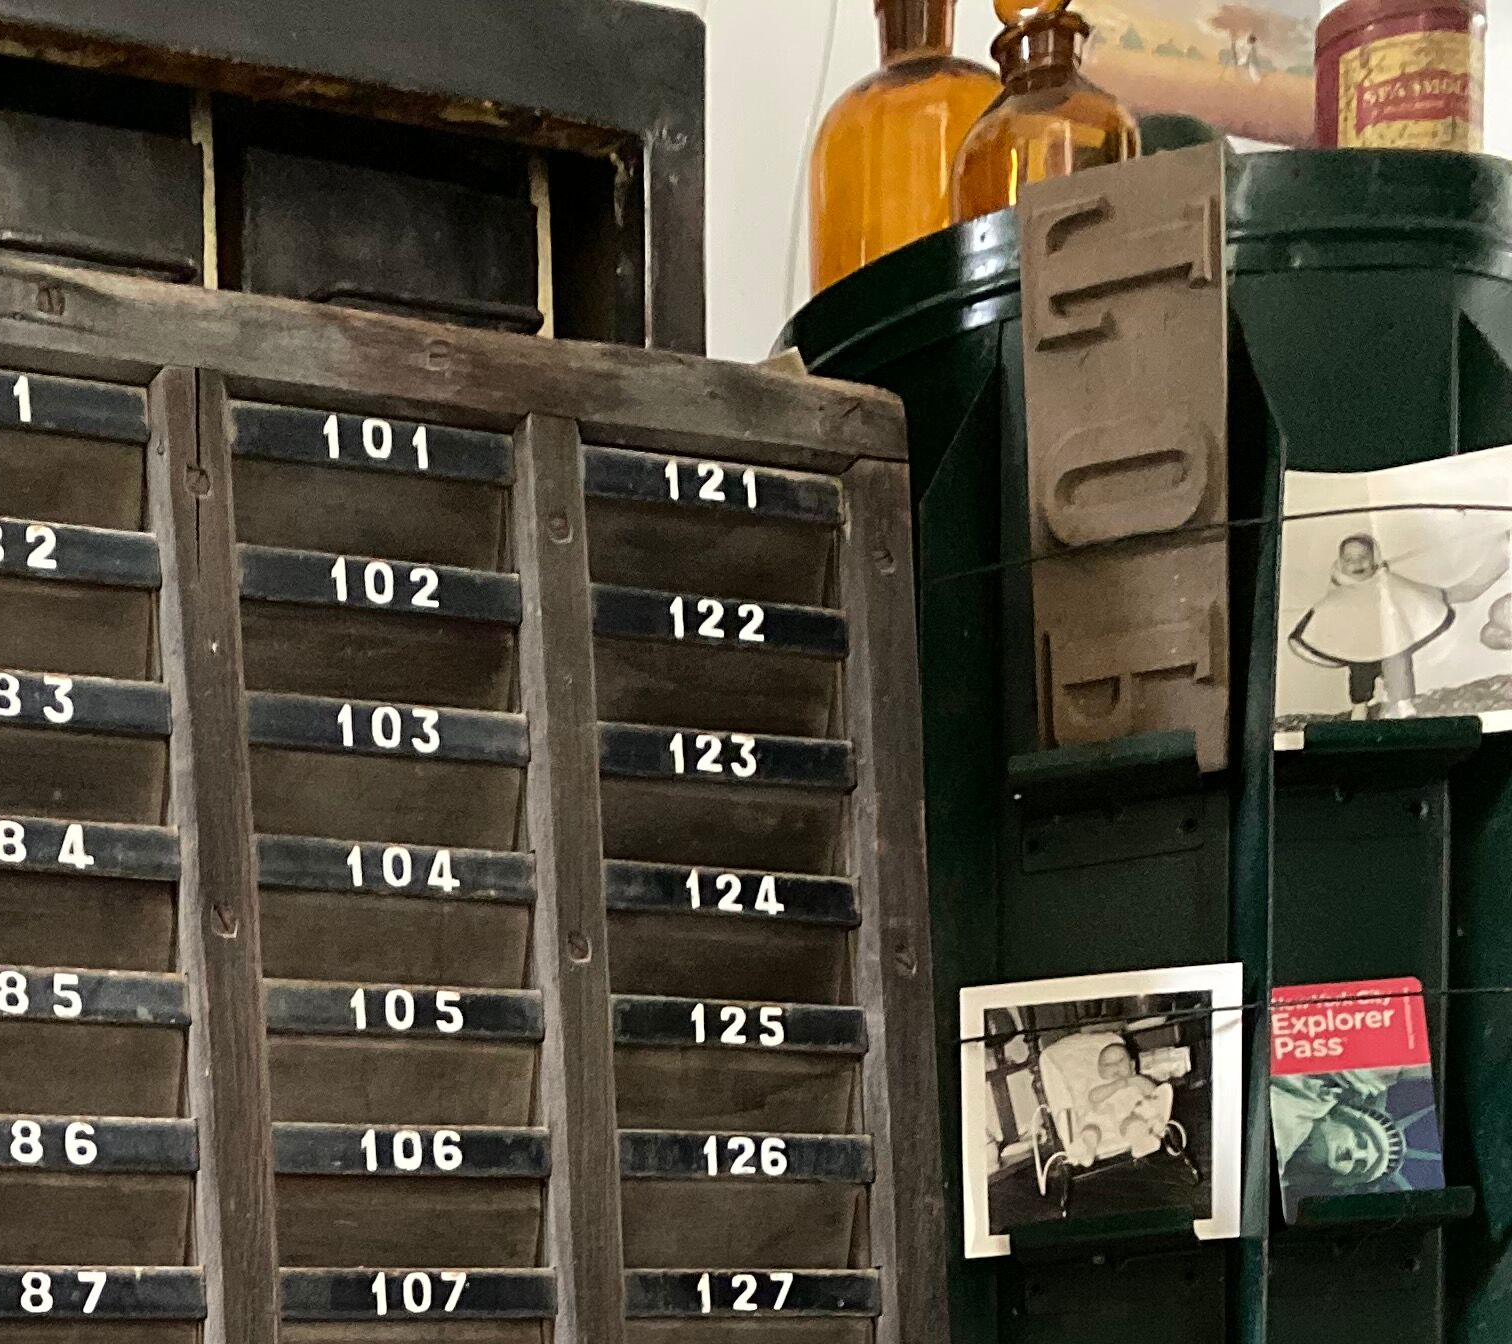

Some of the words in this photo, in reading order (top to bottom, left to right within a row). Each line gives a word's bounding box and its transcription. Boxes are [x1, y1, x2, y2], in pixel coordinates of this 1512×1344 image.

[324, 415, 428, 469] 101
[659, 456, 759, 508] 121
[331, 556, 439, 608] 102
[670, 733, 756, 777] 123
[347, 843, 460, 892] 104
[686, 868, 784, 915] 124
[351, 984, 463, 1033] 105
[692, 1003, 784, 1046] 125
[1271, 1008, 1395, 1038] Explorer
[1274, 1036, 1345, 1060] Pass
[11, 1120, 97, 1165] 86
[361, 1124, 462, 1171] 106
[21, 1269, 106, 1313] 87
[698, 1273, 793, 1313] 127
